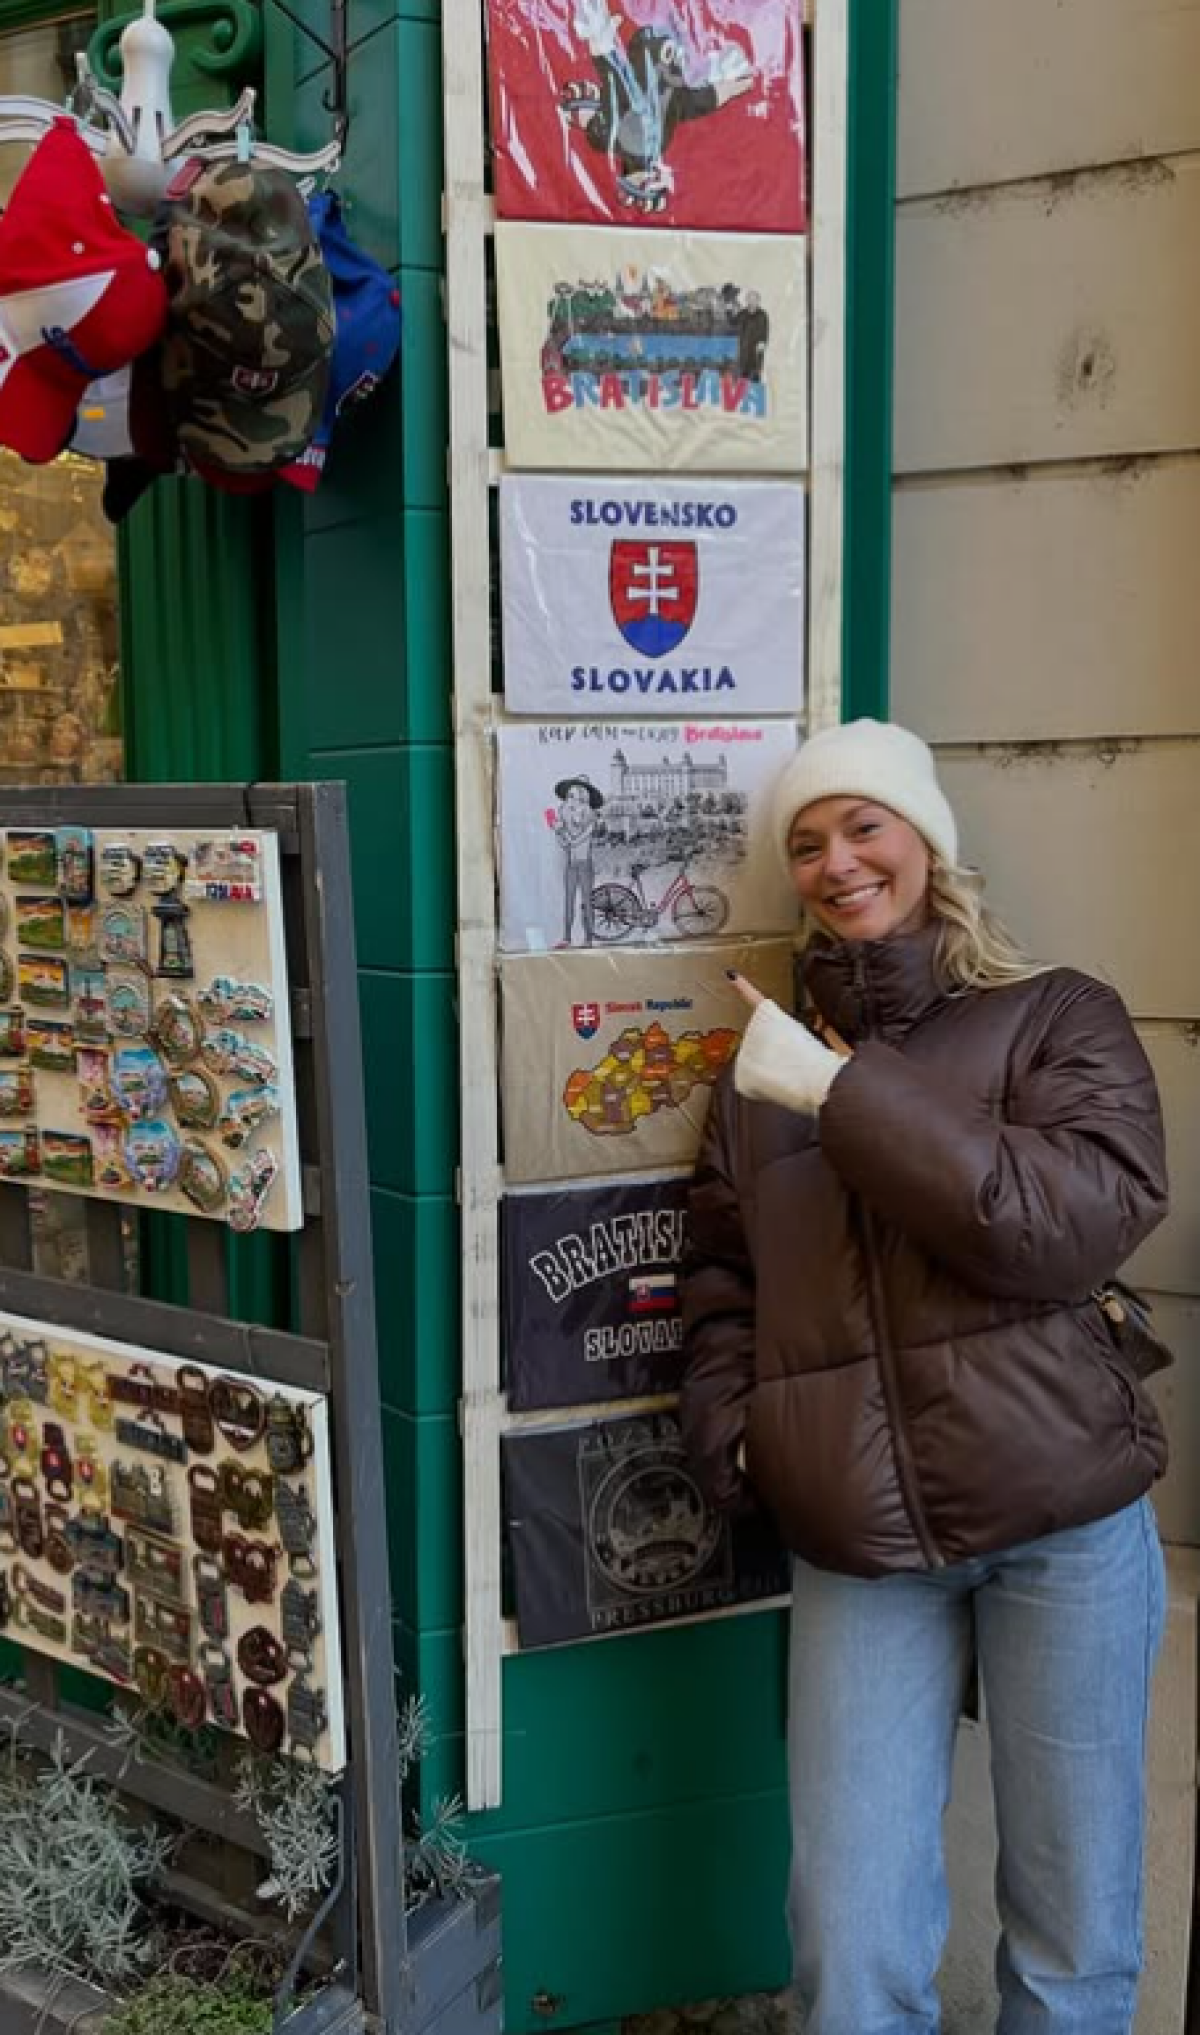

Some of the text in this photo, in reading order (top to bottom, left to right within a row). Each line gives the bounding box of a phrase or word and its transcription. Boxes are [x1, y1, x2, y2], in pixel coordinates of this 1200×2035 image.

[541, 370, 768, 419] BRATISLAVA
[570, 499, 738, 528] SLOVENSKO
[570, 666, 736, 693] SLOVAKIA
[529, 1210, 688, 1303] BRATIS
[584, 1318, 683, 1361] SLOVA
